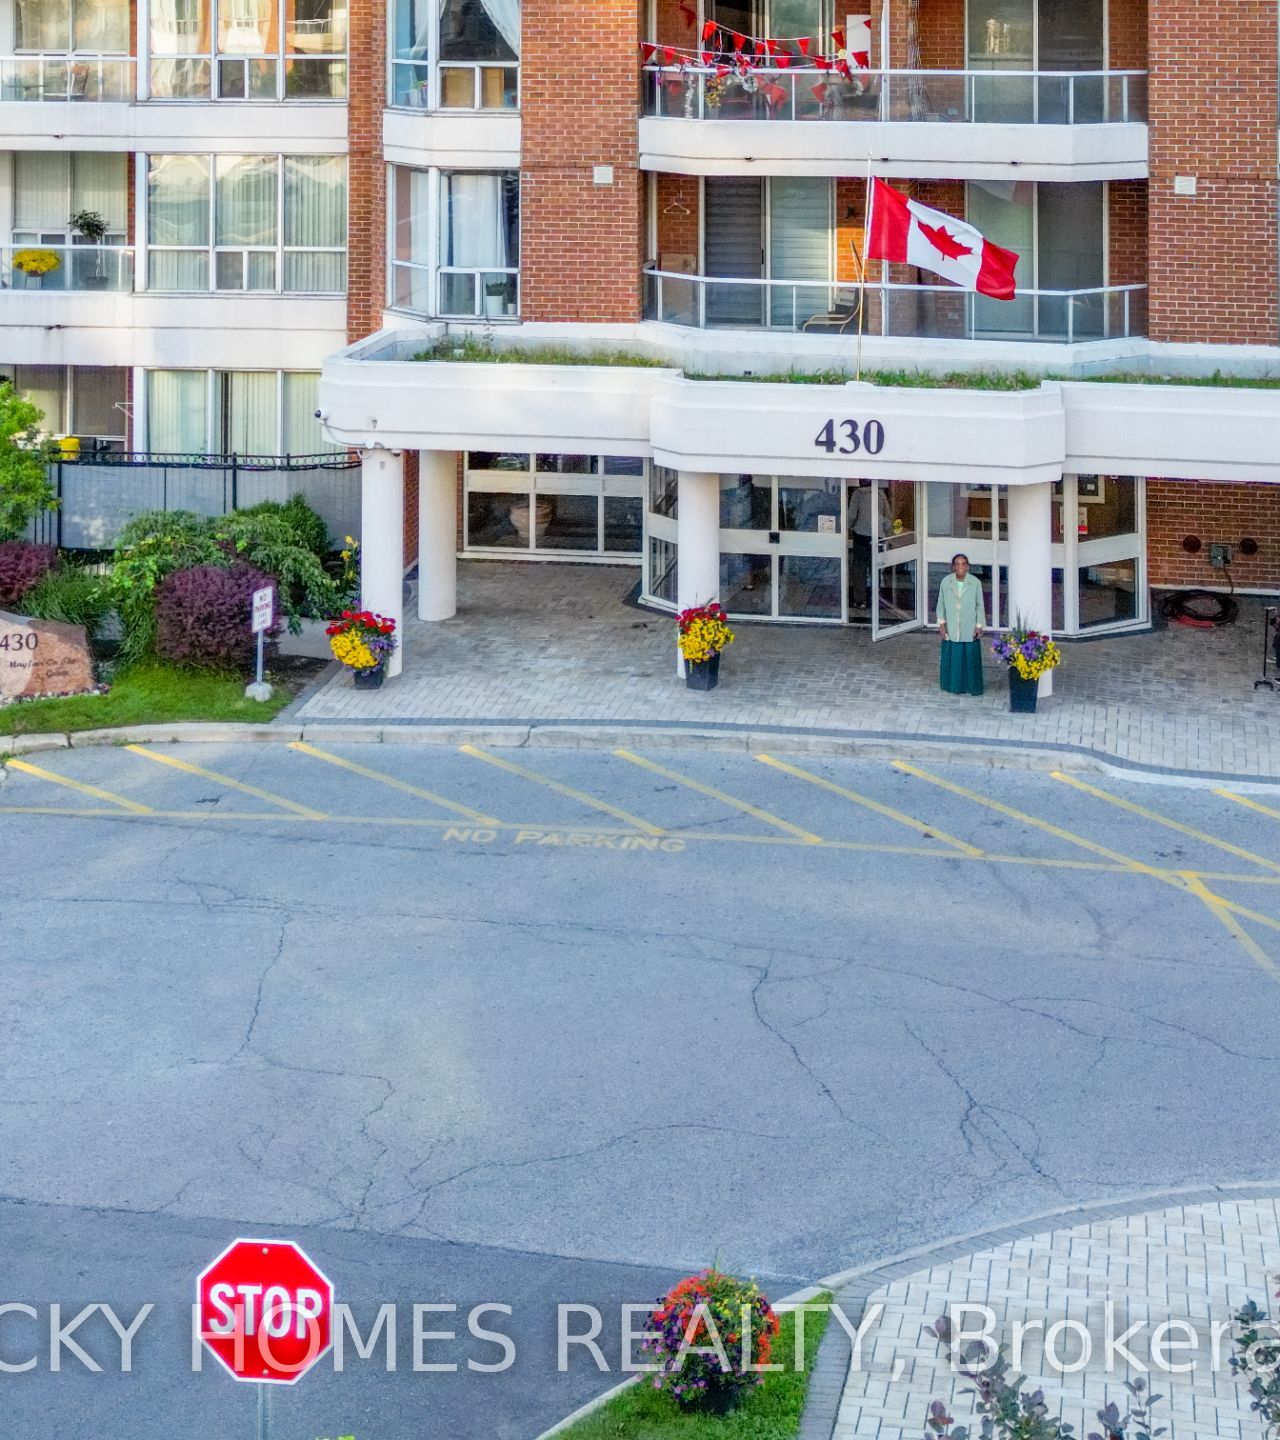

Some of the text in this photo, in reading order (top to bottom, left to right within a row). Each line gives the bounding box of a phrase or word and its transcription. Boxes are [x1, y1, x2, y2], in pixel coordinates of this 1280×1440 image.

[814, 418, 885, 455] 430
[0, 632, 39, 652] 430
[8, 659, 45, 670] Mayfair
[442, 826, 688, 853] NO PARKING
[208, 1282, 323, 1341] STOP
